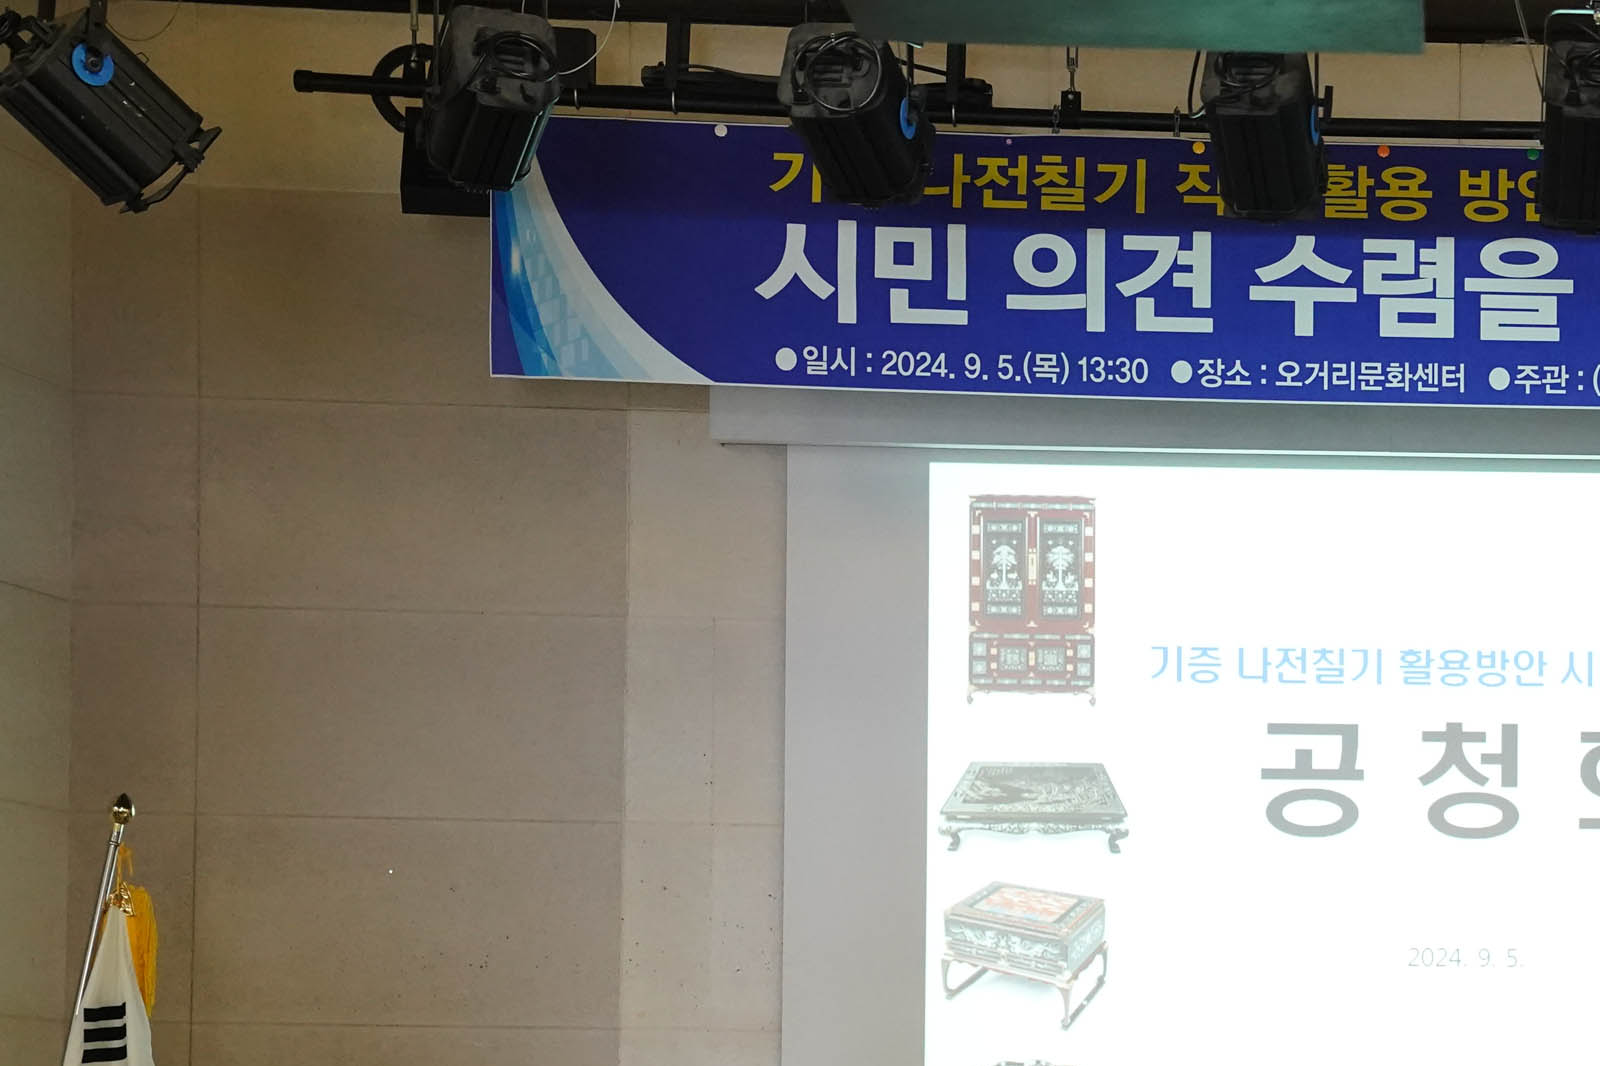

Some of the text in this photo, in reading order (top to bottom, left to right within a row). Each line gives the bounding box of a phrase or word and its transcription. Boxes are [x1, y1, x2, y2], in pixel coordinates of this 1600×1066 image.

[922, 153, 1147, 214] 나전칠기
[1322, 163, 1433, 222] 활용
[754, 219, 969, 326] 시민
[1005, 227, 1214, 333] 의견
[1249, 234, 1574, 342] 수렴을
[880, 350, 957, 380] 2024.
[1077, 355, 1150, 384] 13:30
[1274, 360, 1465, 394] 오거리문화센터
[1150, 645, 1222, 685] 기증
[1237, 646, 1384, 686] 나전칠기
[1399, 648, 1548, 688] 활용방안
[1407, 947, 1466, 969] 2024.
